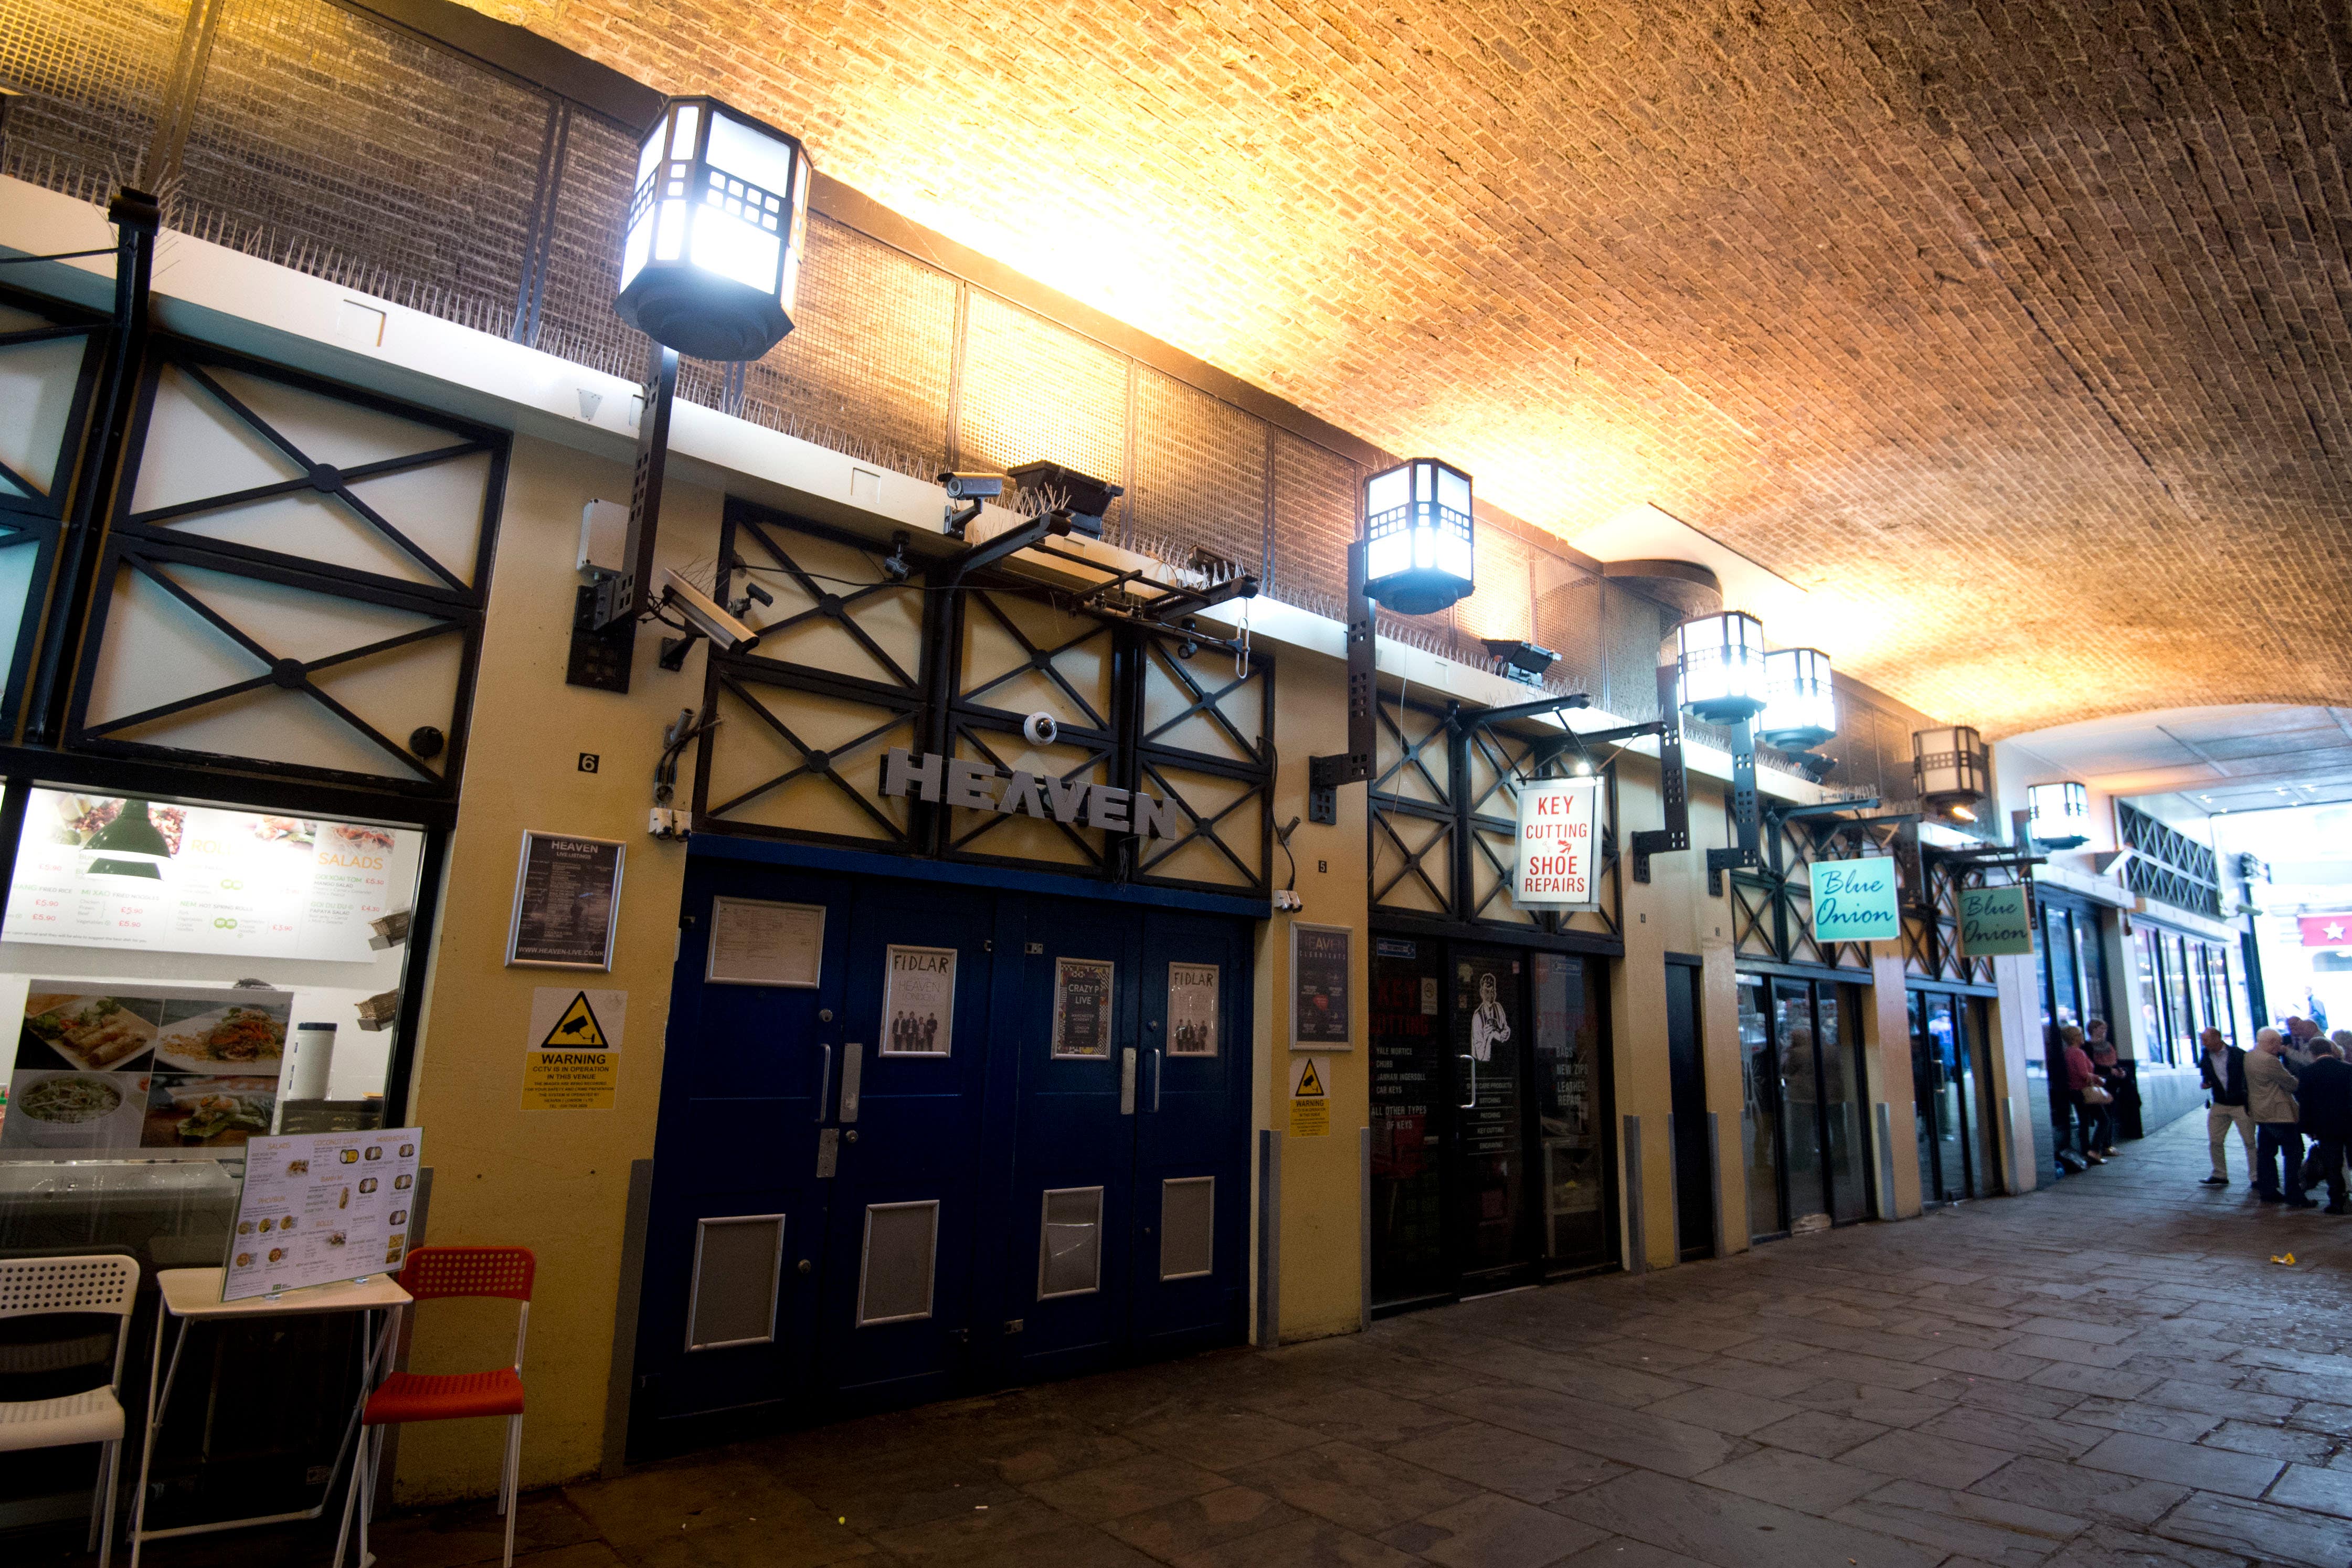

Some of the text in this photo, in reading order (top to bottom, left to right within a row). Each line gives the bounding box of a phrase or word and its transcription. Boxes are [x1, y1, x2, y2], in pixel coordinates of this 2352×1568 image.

[582, 755, 595, 771] 6
[886, 746, 1177, 840] HEAVEN
[1538, 795, 1574, 815] KEY
[1526, 823, 1587, 839] CUTTING
[551, 841, 599, 853] HEAVEN
[319, 852, 384, 871] SALADS
[1320, 862, 1325, 872] 5
[1530, 856, 1577, 875] SHOE
[1525, 877, 1584, 892] REPAIRS
[1821, 869, 1884, 894] Blue
[35, 899, 59, 907] £5.90
[1963, 894, 2017, 916] Blue
[1817, 898, 1893, 925] Onion
[1963, 920, 2028, 943] Onion
[518, 947, 604, 957] WWW.HEAVEN-LIVE.CO.UK
[894, 955, 949, 973] FIDLAR
[899, 980, 940, 992] HEAVEN
[1174, 972, 1214, 987] FIDLAR
[1068, 983, 1093, 993] CRAZY
[1378, 979, 1417, 1008] KEY
[902, 992, 936, 1002] LONDON
[1075, 996, 1092, 1005] LIVE
[1369, 1013, 1428, 1037] CUTTING
[542, 1054, 606, 1064] WARNING
[1556, 1046, 1573, 1058] BAGS
[1557, 1063, 1588, 1075] NEW ZIPS
[1558, 1081, 1586, 1093] LEATHER
[1371, 1105, 1427, 1116] ALL OTHER TYPES
[1386, 1120, 1413, 1129] OF KEYS
